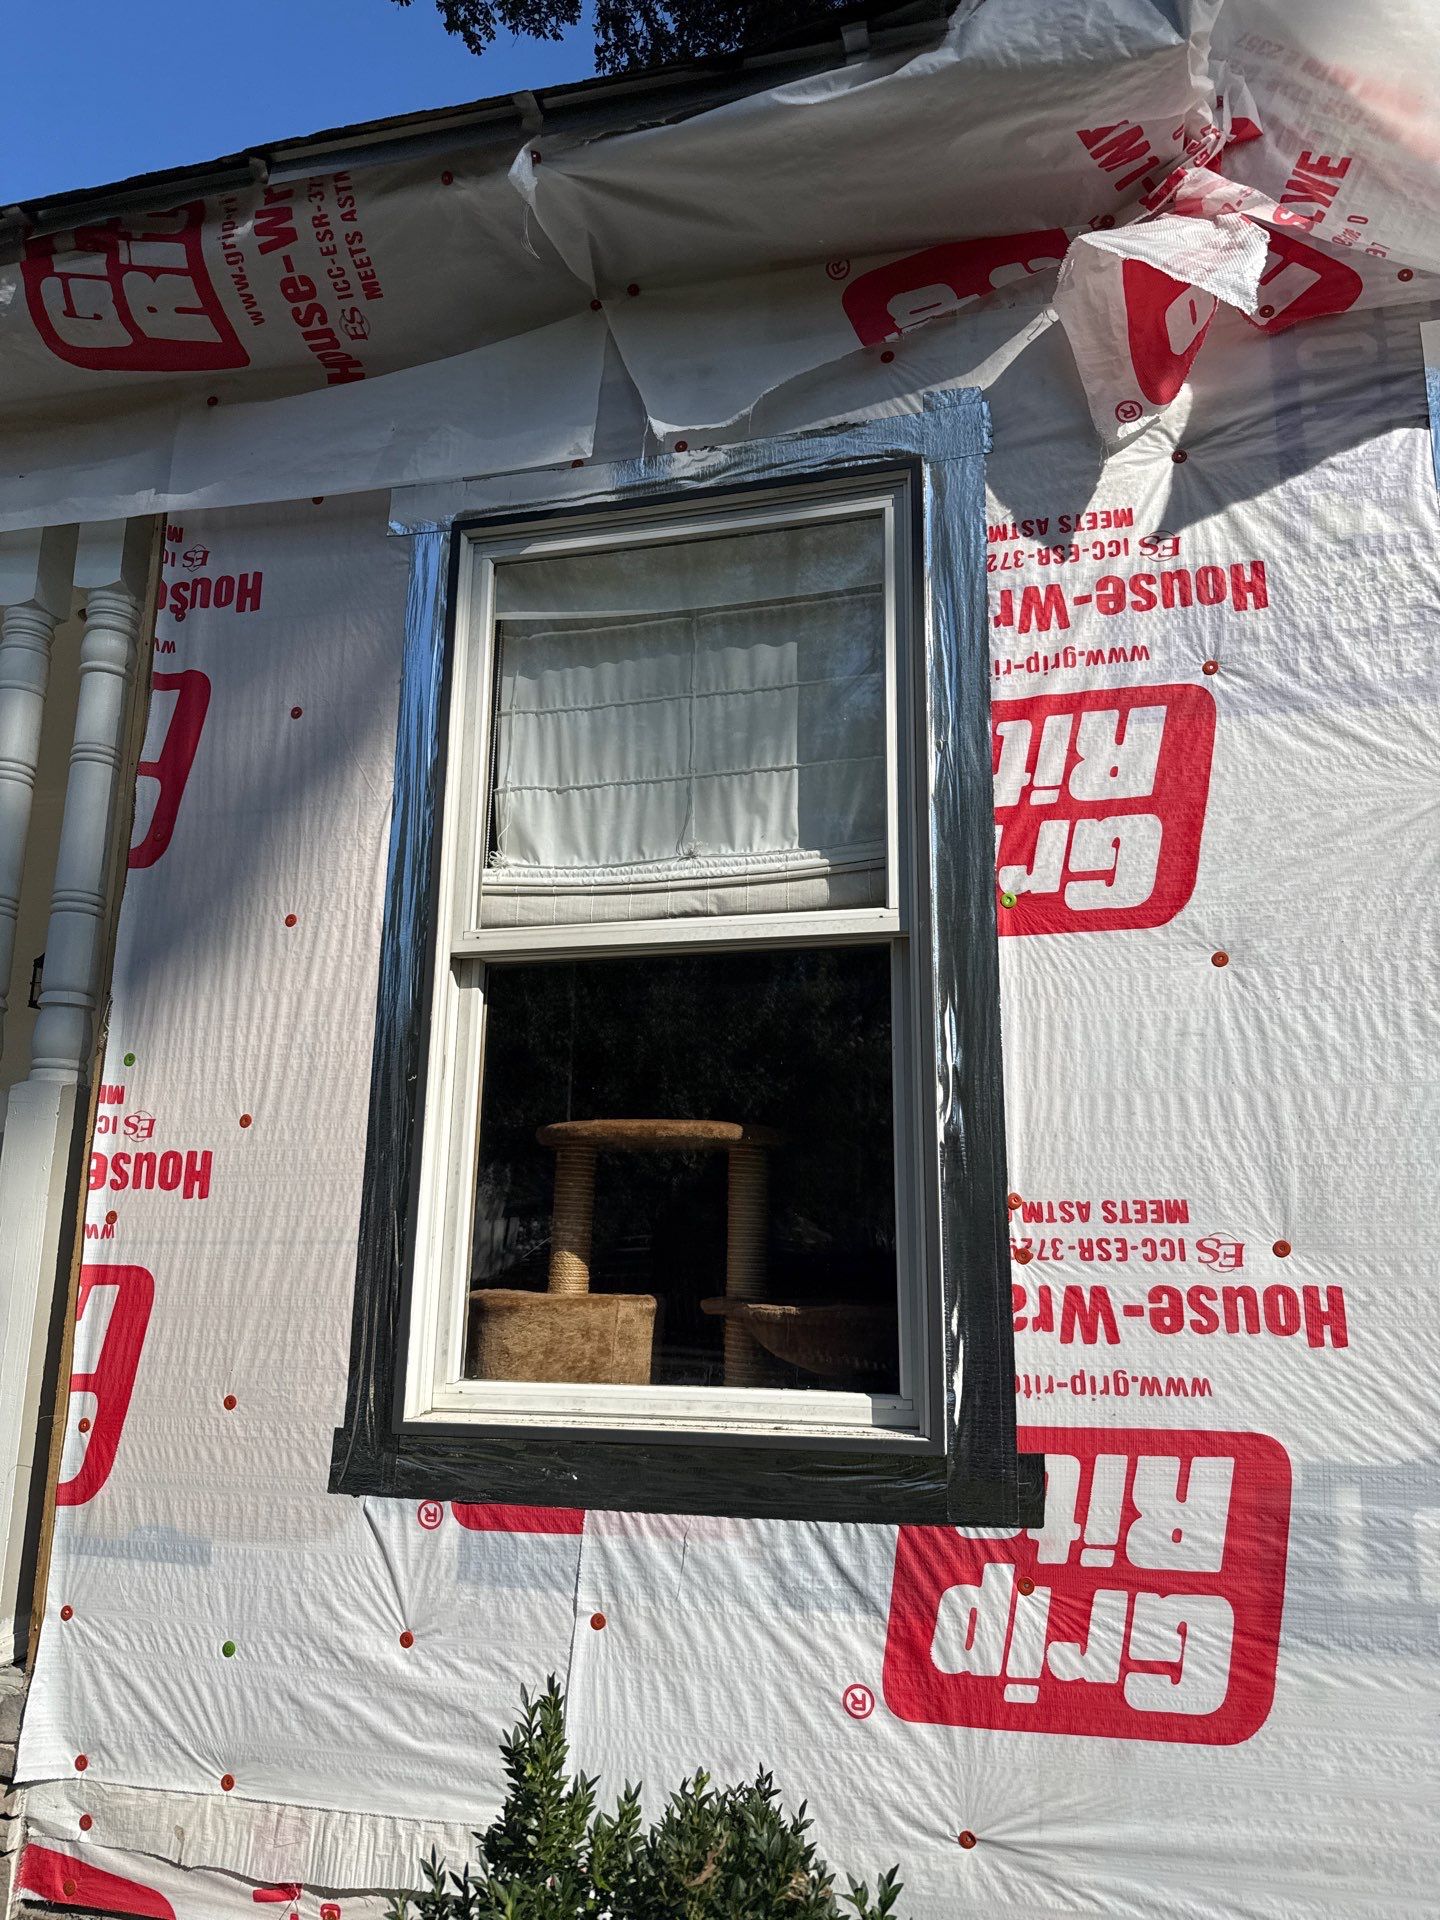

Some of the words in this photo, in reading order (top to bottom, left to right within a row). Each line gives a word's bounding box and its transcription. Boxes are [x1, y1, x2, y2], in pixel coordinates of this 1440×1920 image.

[345, 230, 384, 301] MEETS
[987, 518, 1049, 543] ASTM
[1058, 508, 1134, 533] MEETS
[992, 560, 1269, 634] House-Wr
[988, 645, 1150, 681] www.grip-ri
[1021, 1199, 1092, 1224] ASTM
[1100, 1199, 1190, 1224] MEETS
